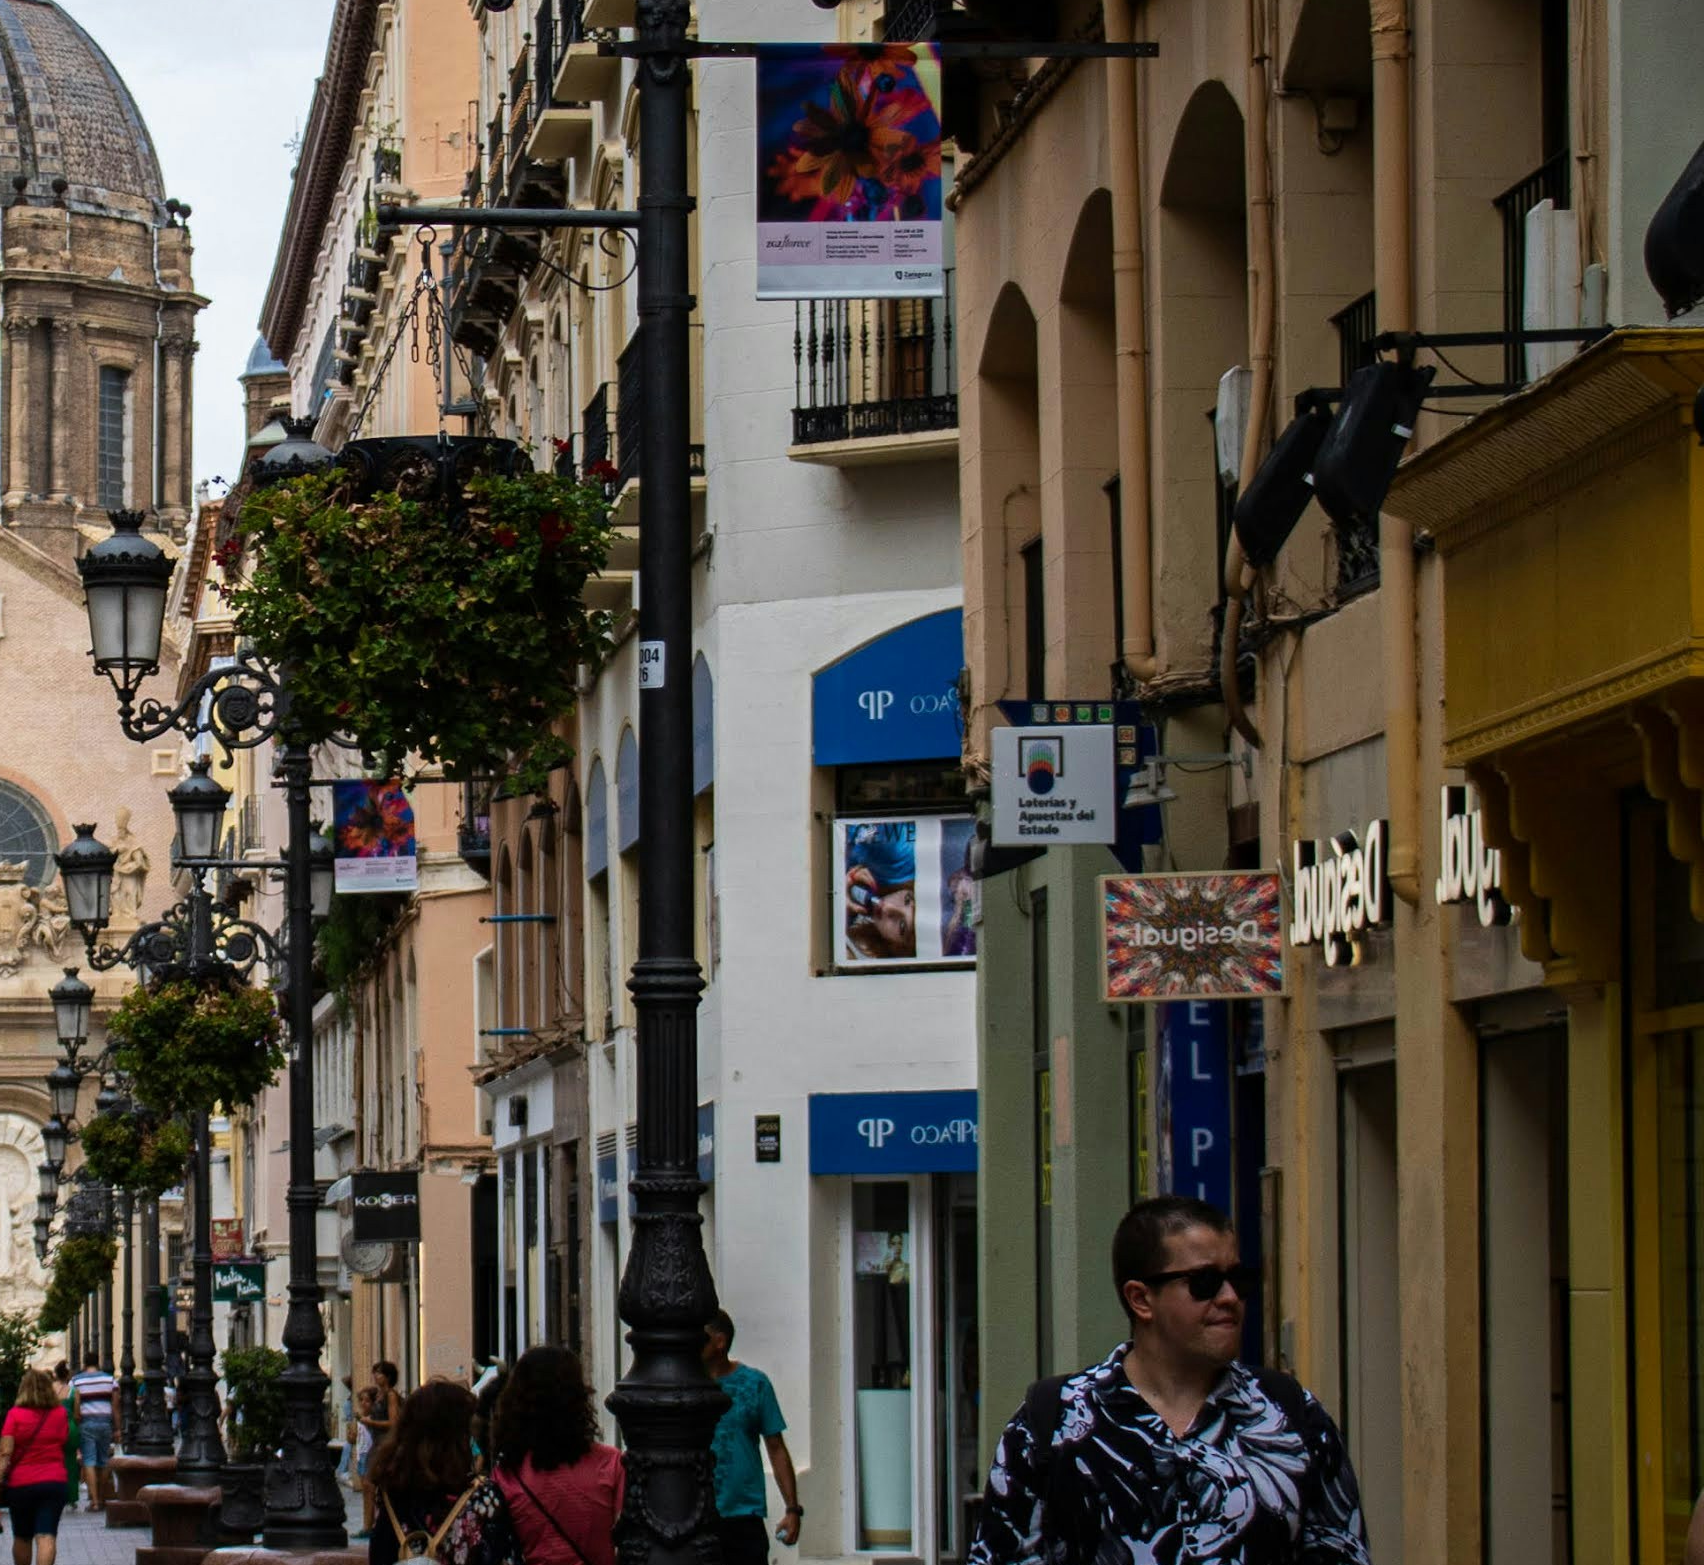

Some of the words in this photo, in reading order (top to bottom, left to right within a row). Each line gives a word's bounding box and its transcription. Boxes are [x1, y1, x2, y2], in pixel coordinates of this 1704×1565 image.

[1068, 799, 1077, 810] y
[1018, 811, 1074, 823] Apuestas
[1076, 809, 1095, 821] del
[1018, 824, 1060, 835] Estado
